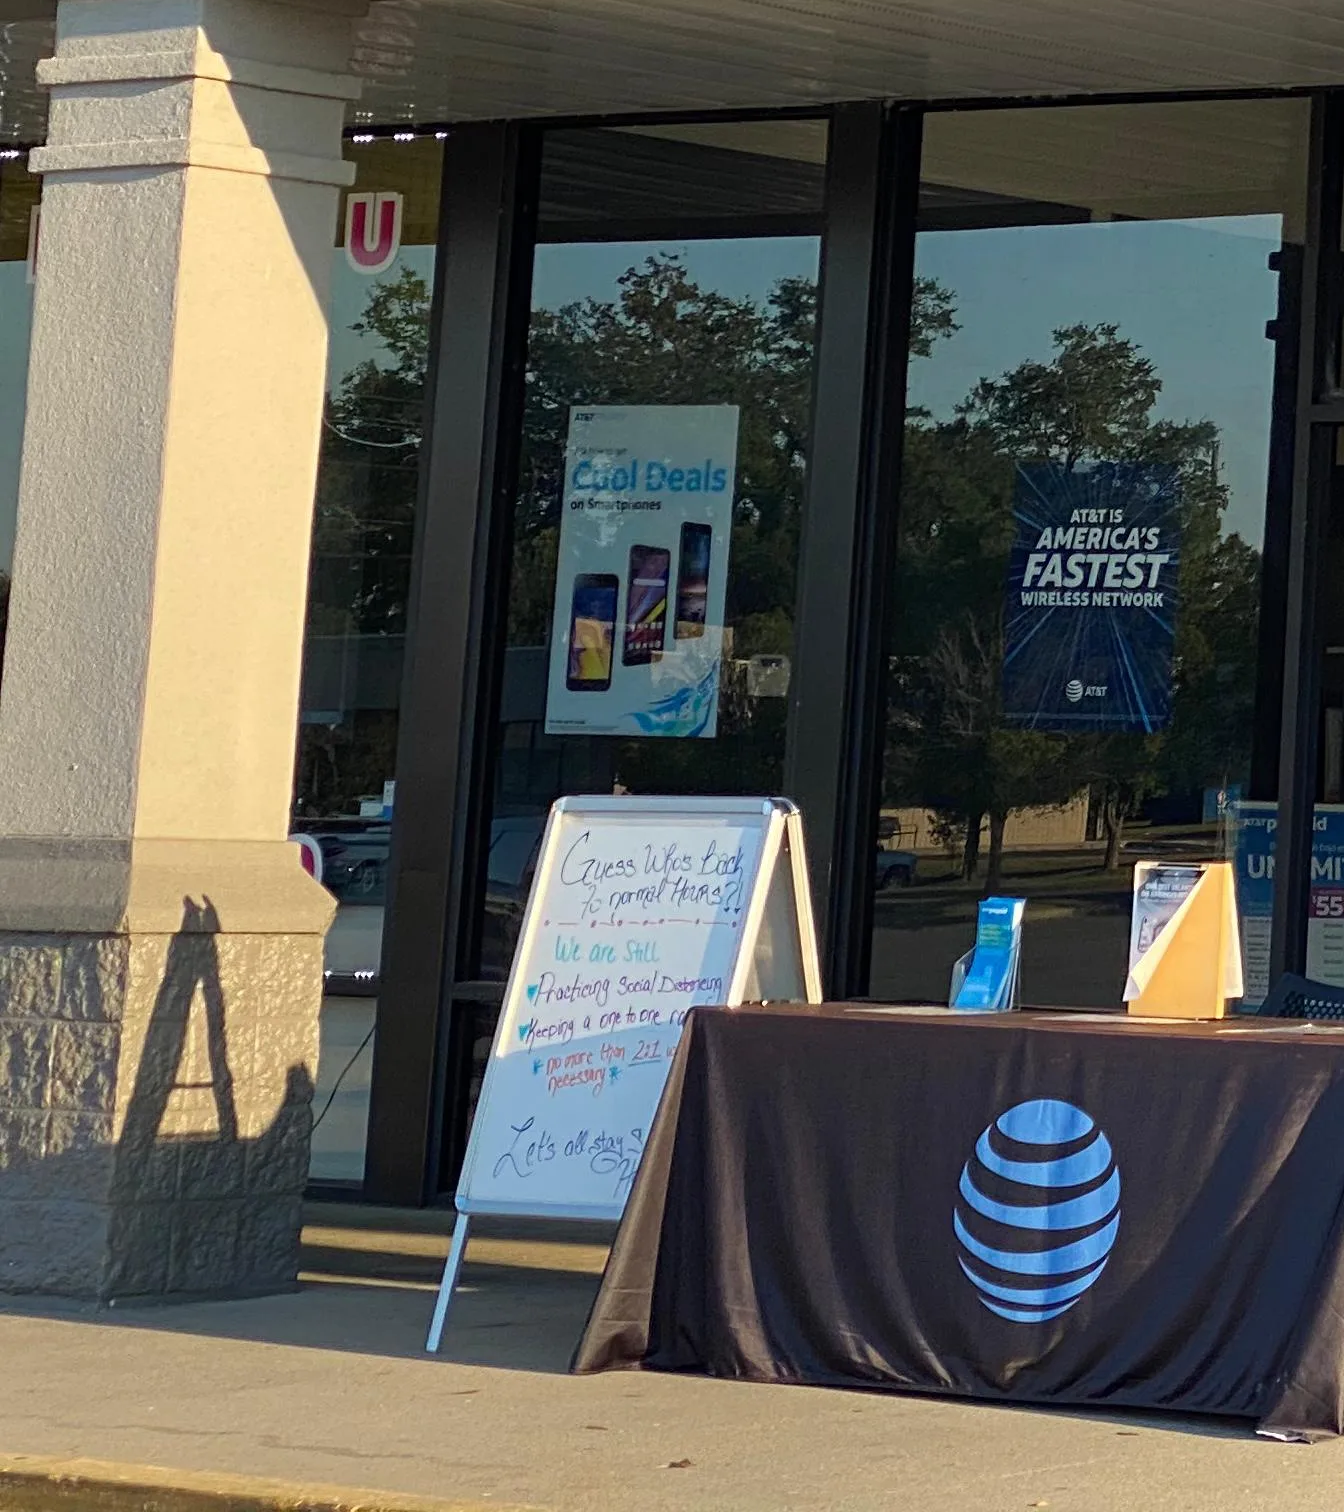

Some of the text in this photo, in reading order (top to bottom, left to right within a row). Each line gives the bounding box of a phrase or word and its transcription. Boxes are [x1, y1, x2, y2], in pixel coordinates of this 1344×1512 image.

[572, 459, 727, 492] Cool Deals
[571, 497, 662, 511] on Smartphones
[1070, 509, 1123, 523] AT&T IS
[1036, 527, 1160, 550] AMERICA'S
[1022, 554, 1169, 588] FASTEST
[1021, 591, 1164, 607] WIRELESS NETWORK
[1085, 686, 1108, 697] AT&T
[561, 830, 636, 886] Guess
[609, 878, 666, 912] normal
[555, 935, 580, 962] We
[589, 943, 616, 964] are
[534, 971, 610, 1007] Practicing
[617, 970, 658, 996] Social
[526, 1017, 574, 1053] Keeping
[583, 1016, 590, 1029] a
[600, 1008, 621, 1032] one
[626, 1005, 635, 1023] to
[639, 1008, 661, 1026] one
[547, 1066, 606, 1098] necessary
[492, 1116, 556, 1179] Let's
[564, 1128, 588, 1157] all
[588, 1129, 624, 1160] stay
